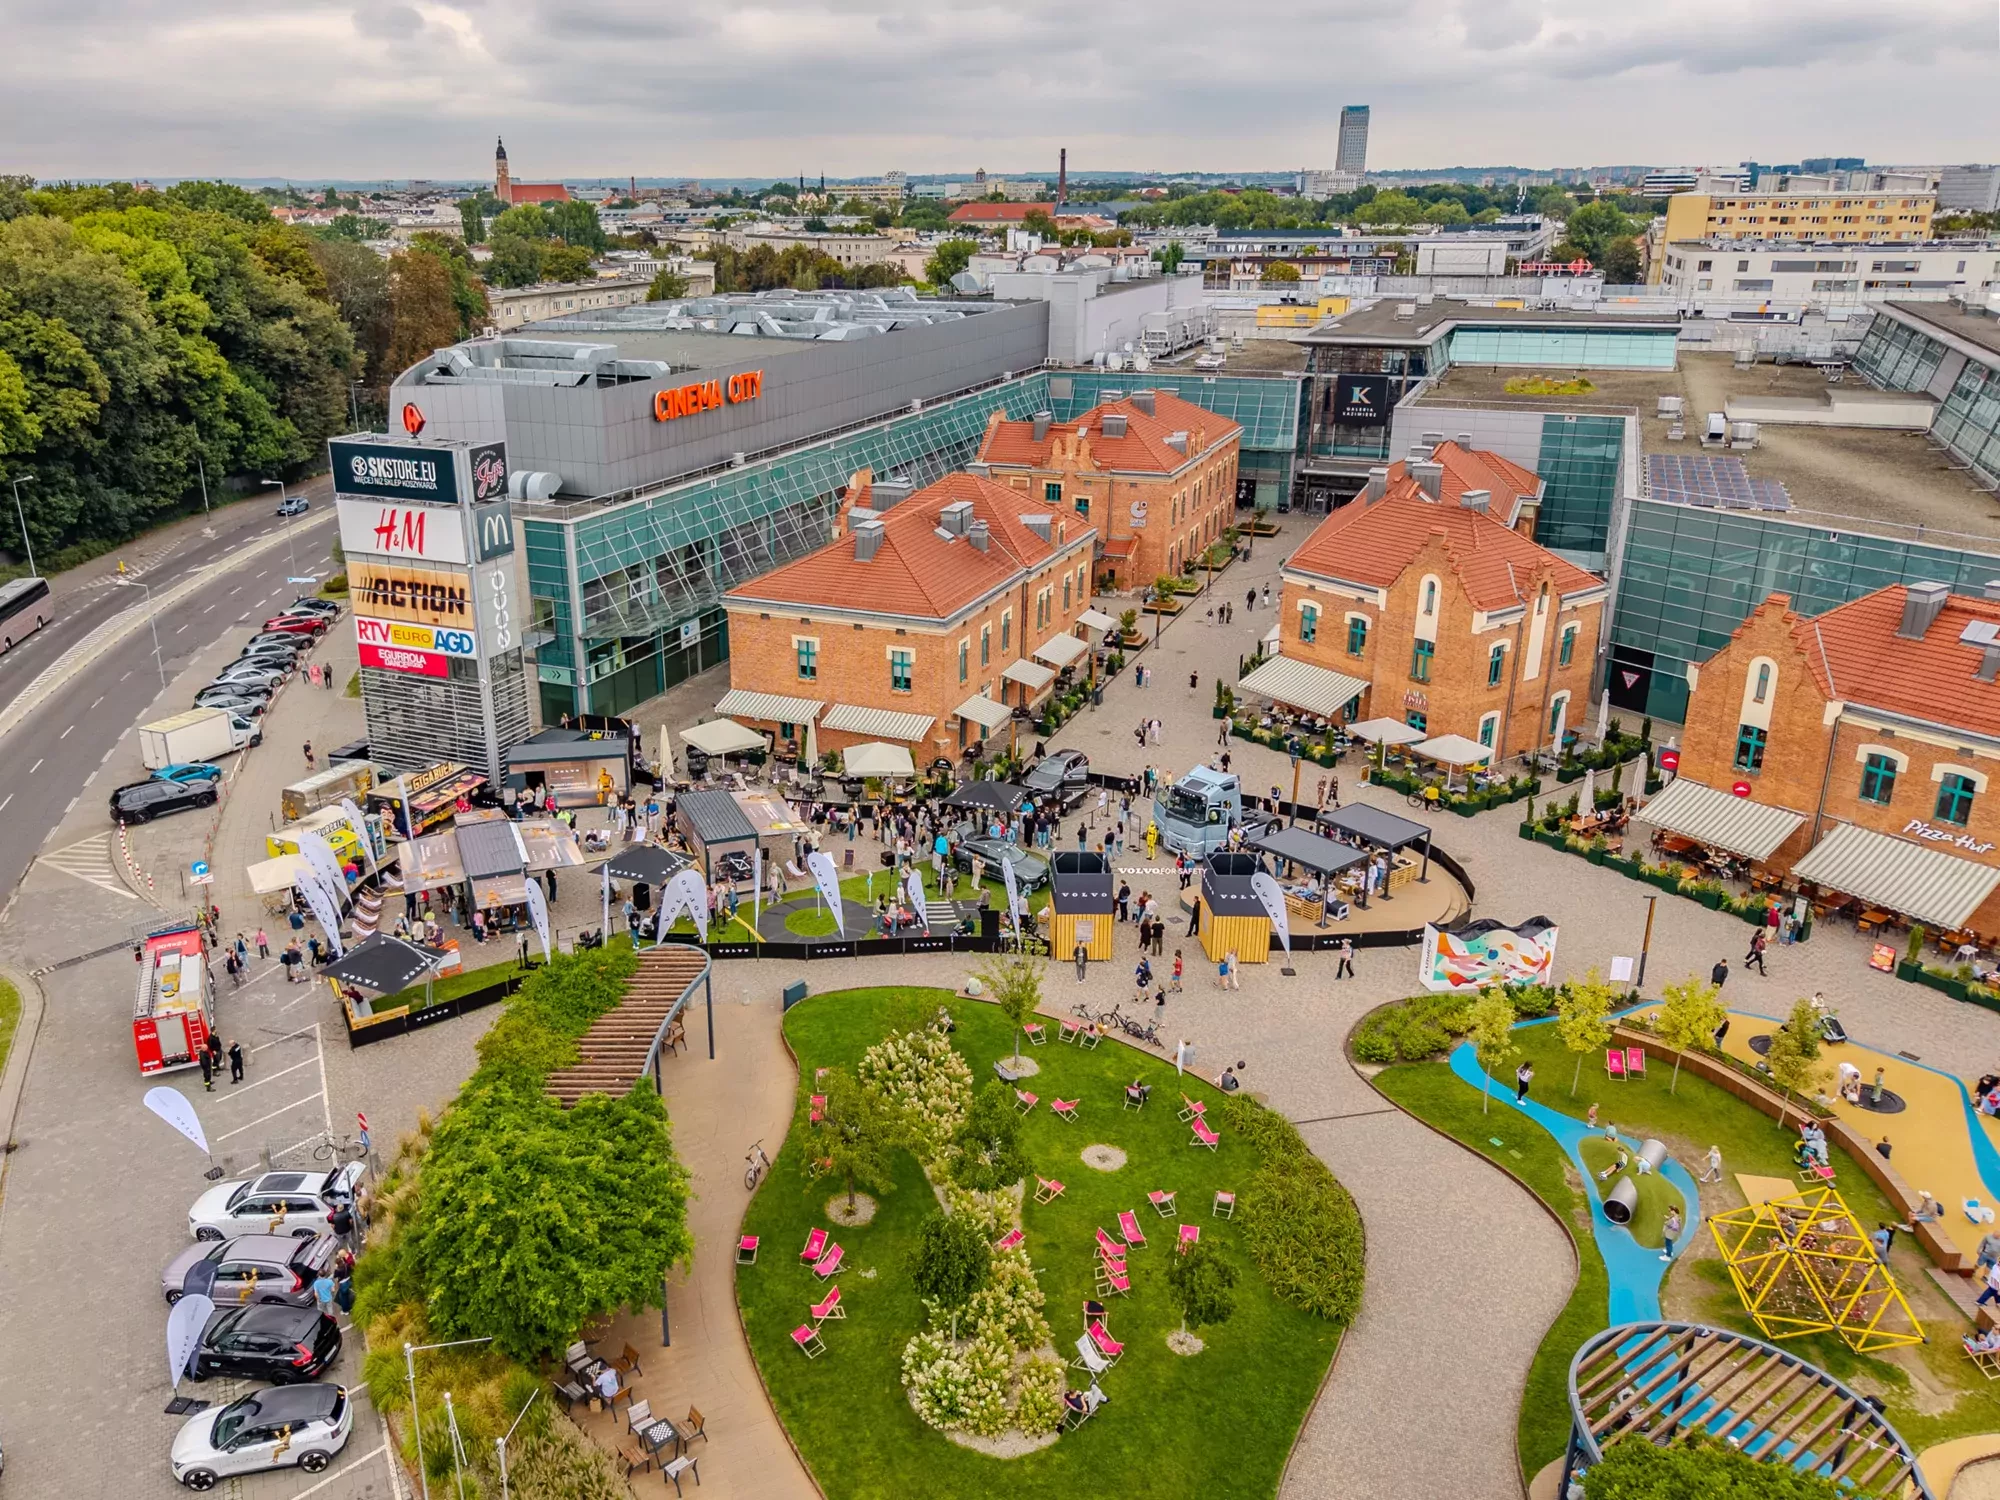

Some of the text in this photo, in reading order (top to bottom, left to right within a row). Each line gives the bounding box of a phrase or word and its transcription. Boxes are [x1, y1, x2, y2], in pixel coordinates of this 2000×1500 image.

[654, 369, 764, 423] CINEMA CITY
[1350, 386, 1371, 404] K
[368, 457, 437, 482] SKSTORE.EU
[384, 479, 402, 487] SKLEP
[402, 480, 438, 490] KOSZYKARZA
[373, 508, 426, 555] H&M
[484, 513, 511, 551] M
[372, 577, 465, 615] ACTION
[357, 619, 474, 654] RTV EURO AGD
[1902, 819, 1996, 854] Pizza Hut
[1178, 867, 1208, 875] SAFETY
[664, 898, 682, 922] VOL
